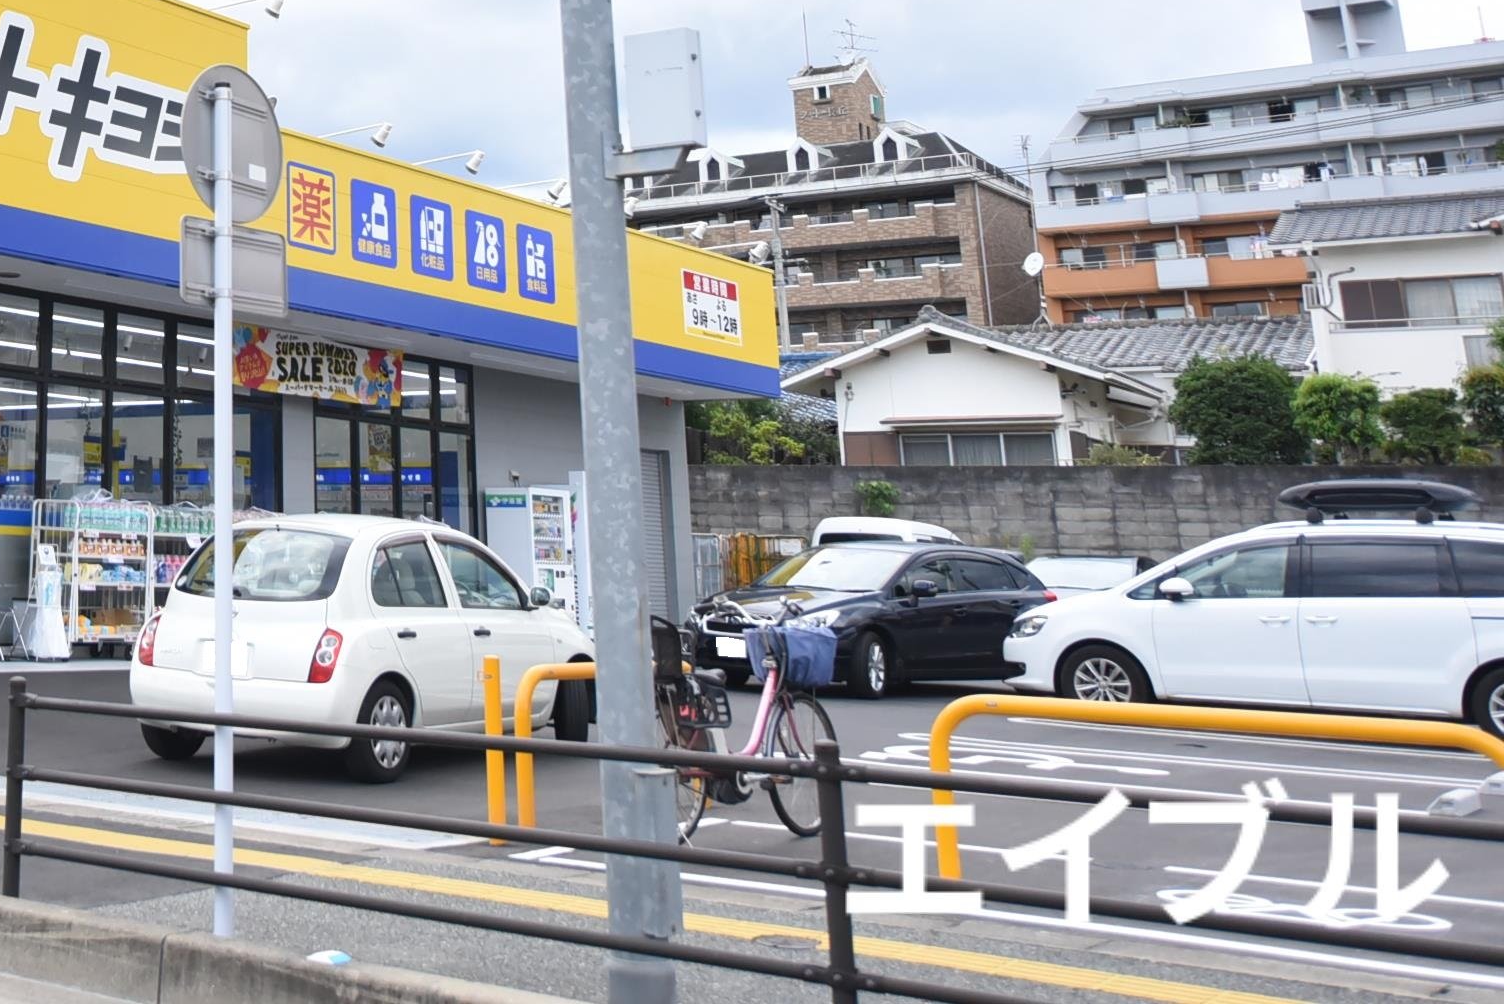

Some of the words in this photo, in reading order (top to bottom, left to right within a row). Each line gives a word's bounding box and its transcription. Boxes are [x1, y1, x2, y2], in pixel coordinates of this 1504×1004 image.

[291, 171, 332, 246] 薬
[357, 237, 392, 260] 健康食品
[421, 252, 445, 272] 化粧品
[476, 266, 499, 284] 日用品
[526, 278, 548, 295] 食料品
[693, 274, 728, 299] 営業時間
[275, 341, 311, 356] SUPER
[312, 341, 358, 362] SUMMER
[276, 357, 324, 383] SALE
[327, 358, 357, 377] 2020
